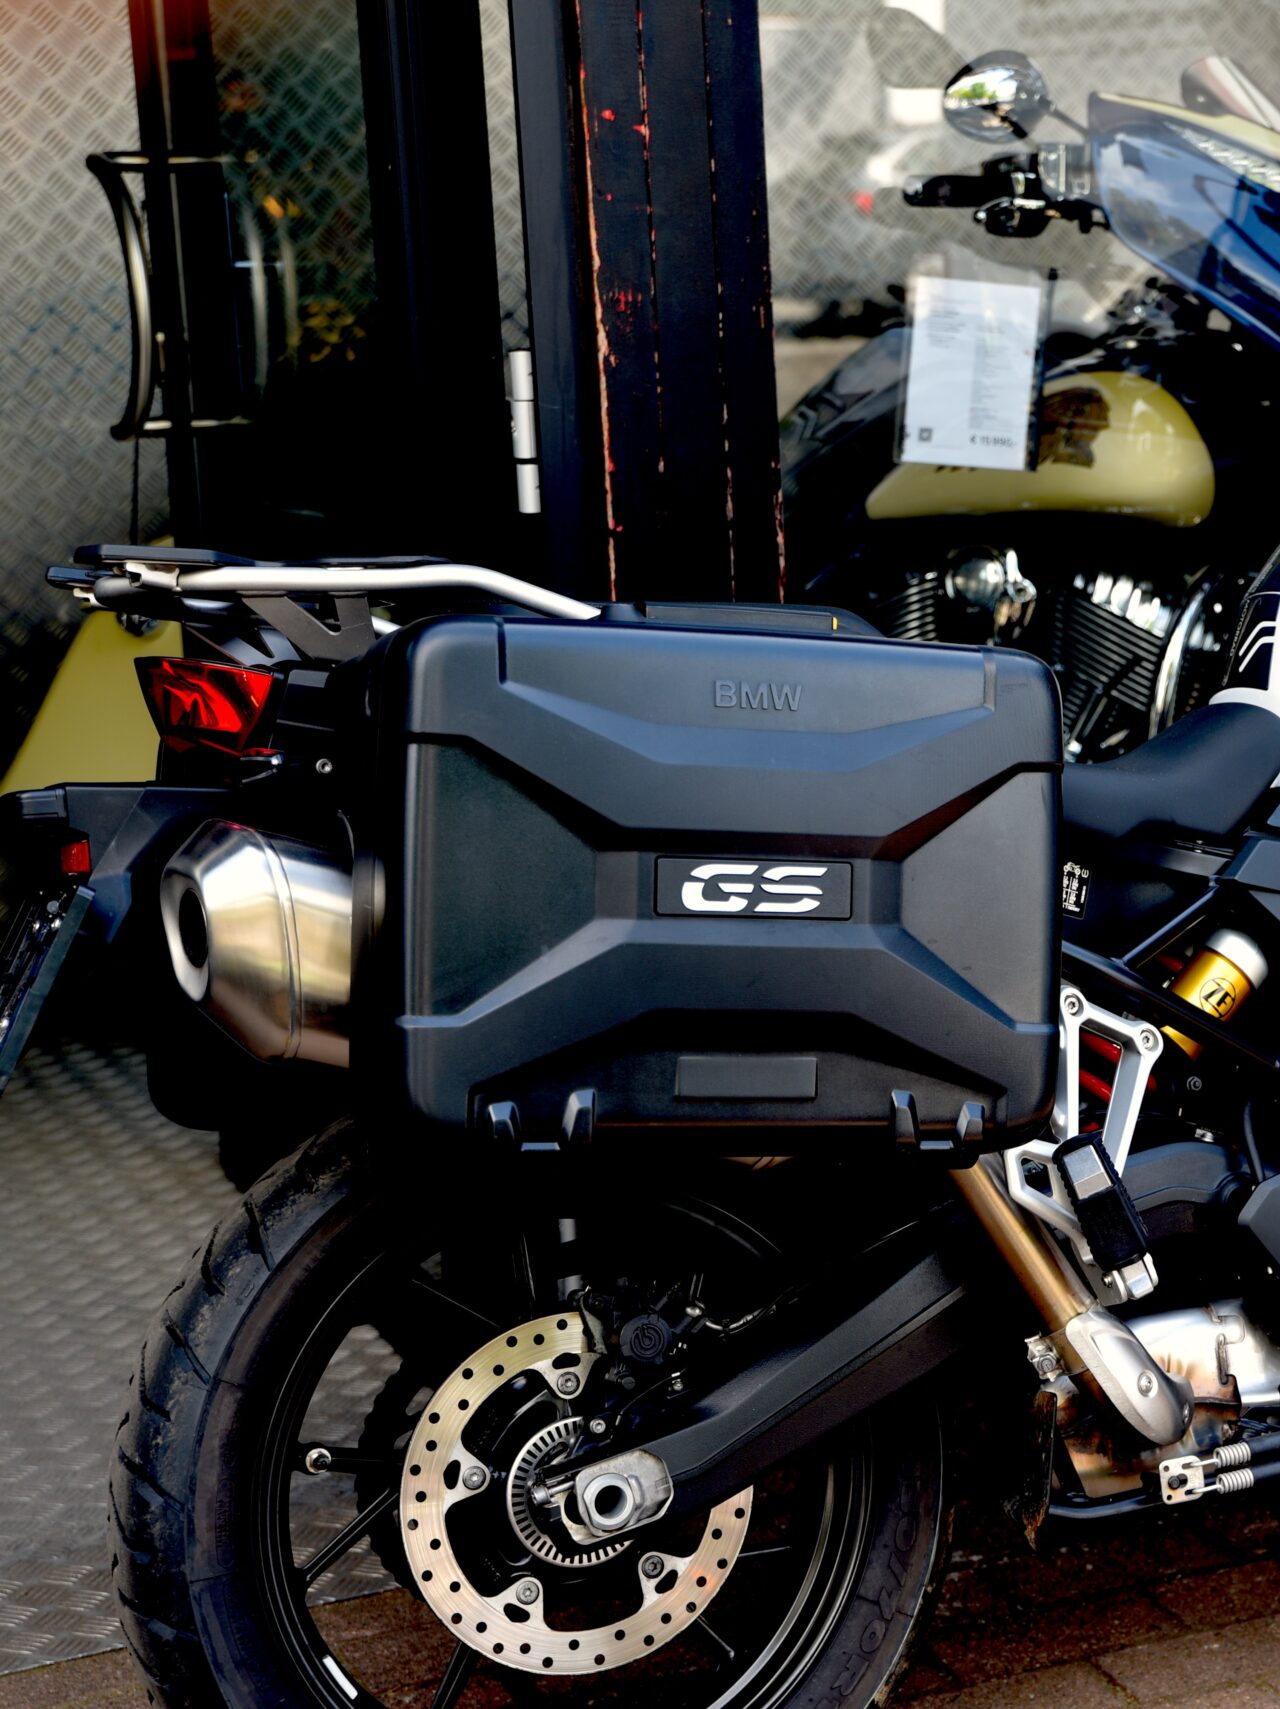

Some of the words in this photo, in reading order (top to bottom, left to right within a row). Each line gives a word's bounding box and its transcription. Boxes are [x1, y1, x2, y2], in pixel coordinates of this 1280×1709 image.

[714, 679, 802, 711] BMW
[681, 863, 828, 913] GS
[1200, 978, 1235, 1017] ZF
